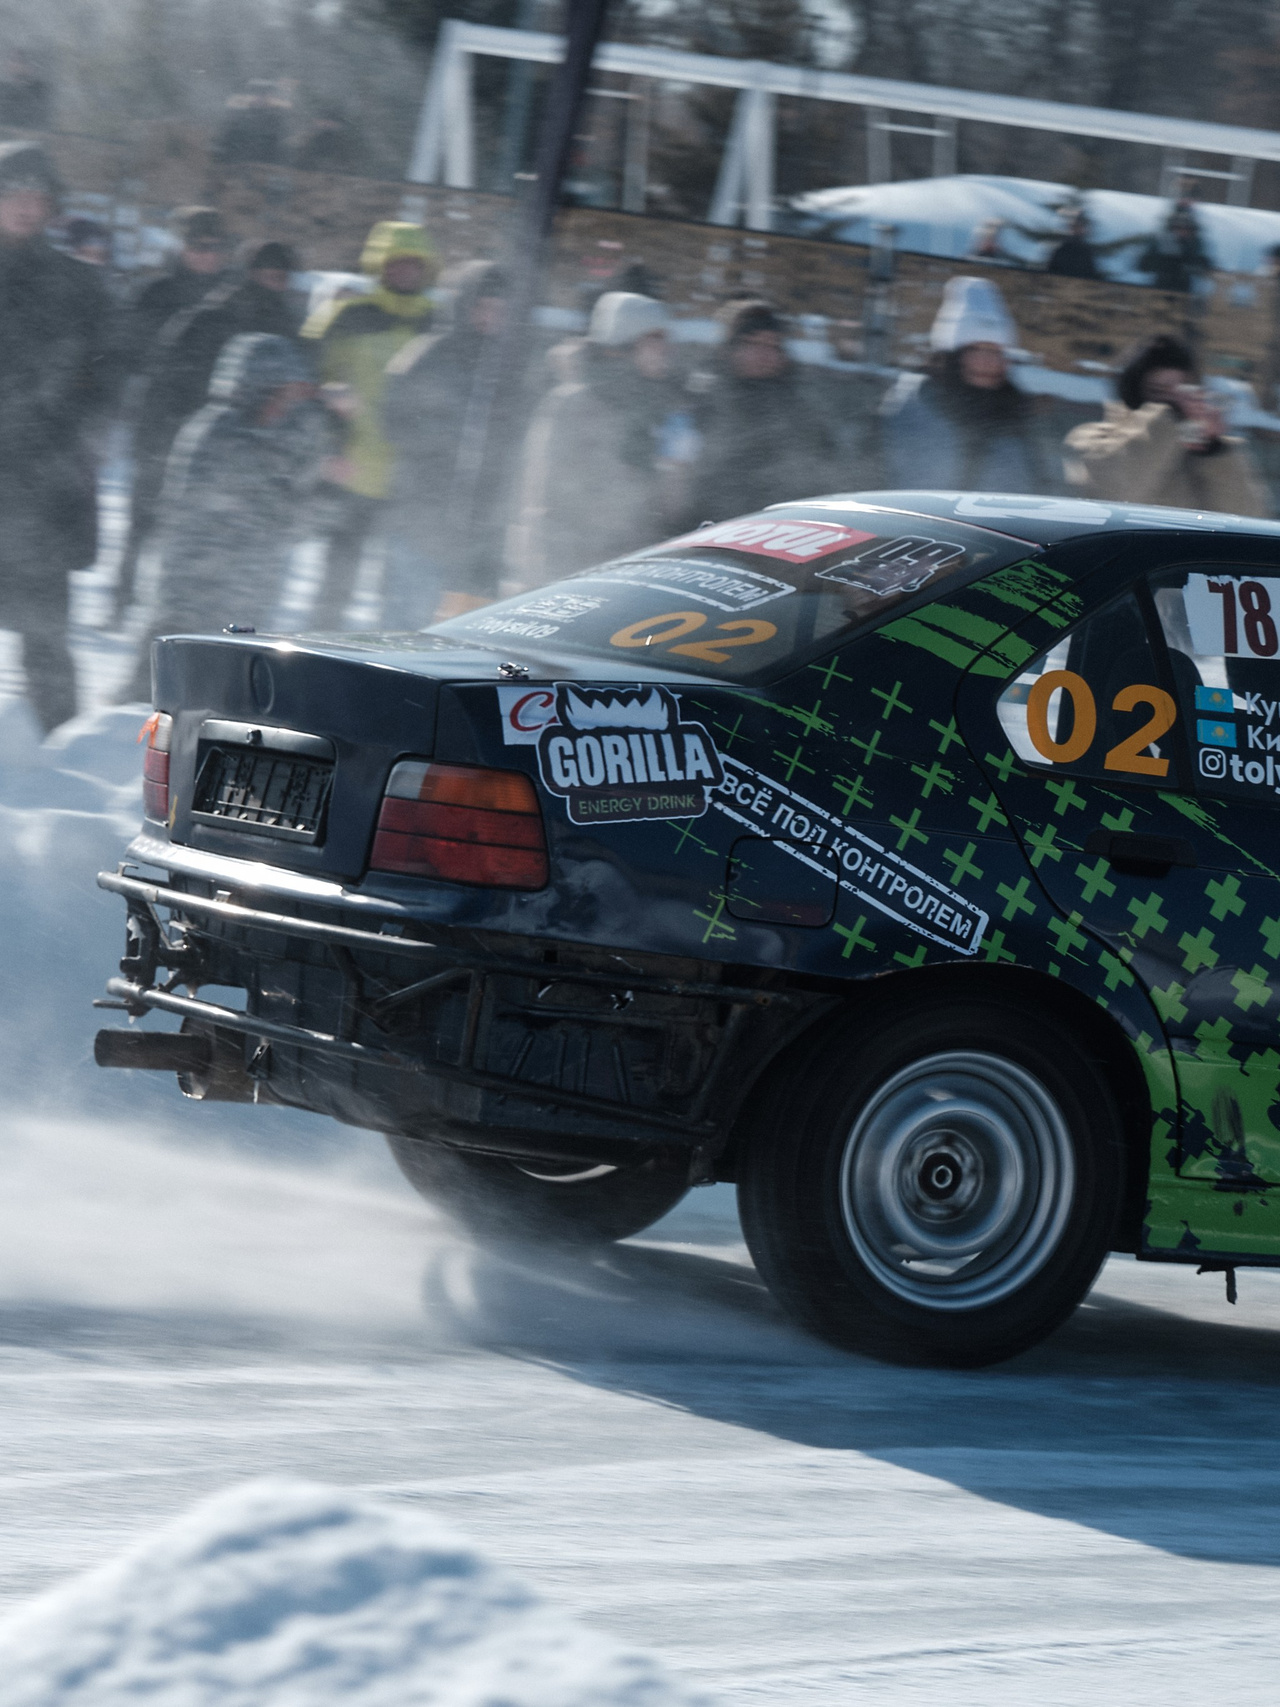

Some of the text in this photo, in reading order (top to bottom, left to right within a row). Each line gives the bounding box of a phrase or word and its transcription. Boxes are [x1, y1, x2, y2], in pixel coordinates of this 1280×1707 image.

[610, 611, 777, 664] 02
[1207, 579, 1278, 657] 78
[1027, 669, 1177, 777] 02
[548, 733, 715, 788] GORILLA
[578, 794, 696, 815] ENERGY DRINK
[718, 774, 973, 939] ВСЁ ПОД КОНТРОЛЕМ
